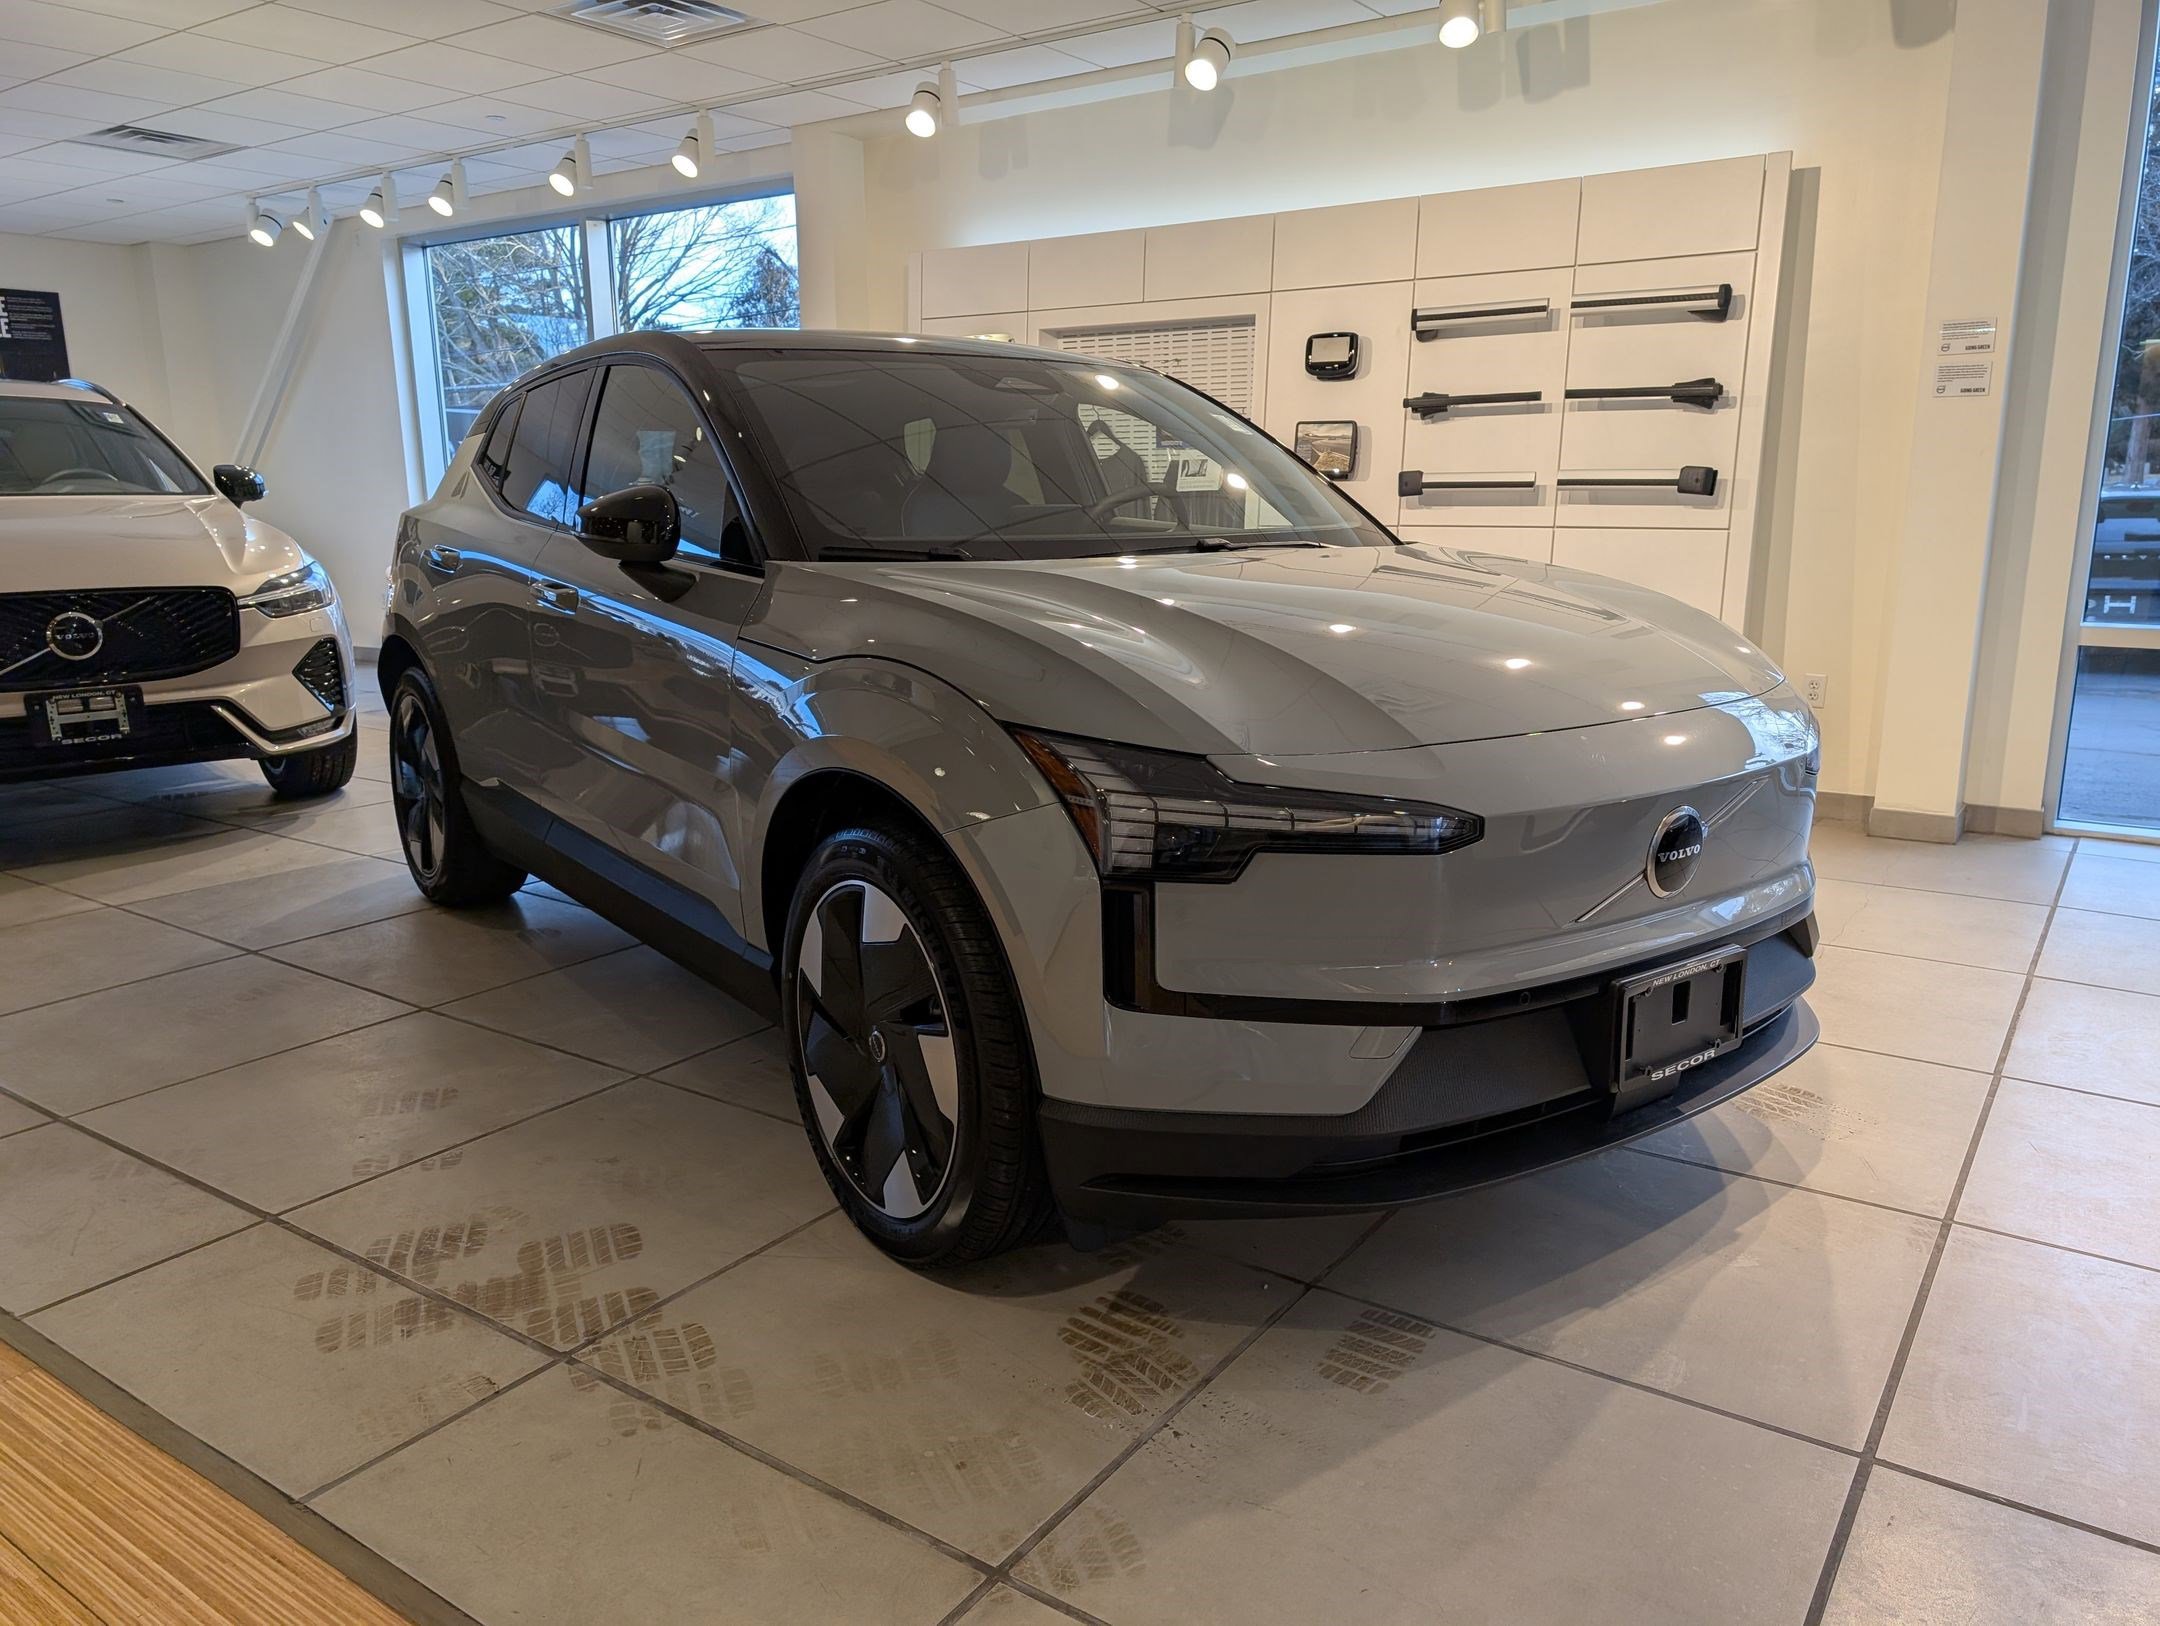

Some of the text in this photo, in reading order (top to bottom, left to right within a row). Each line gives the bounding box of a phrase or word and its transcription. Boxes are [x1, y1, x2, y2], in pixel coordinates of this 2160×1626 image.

[61, 733, 122, 745] SECOR
[1658, 844, 1701, 862] VOLVO
[1653, 975, 1673, 987] NEW
[1651, 1049, 1716, 1081] SECOR
